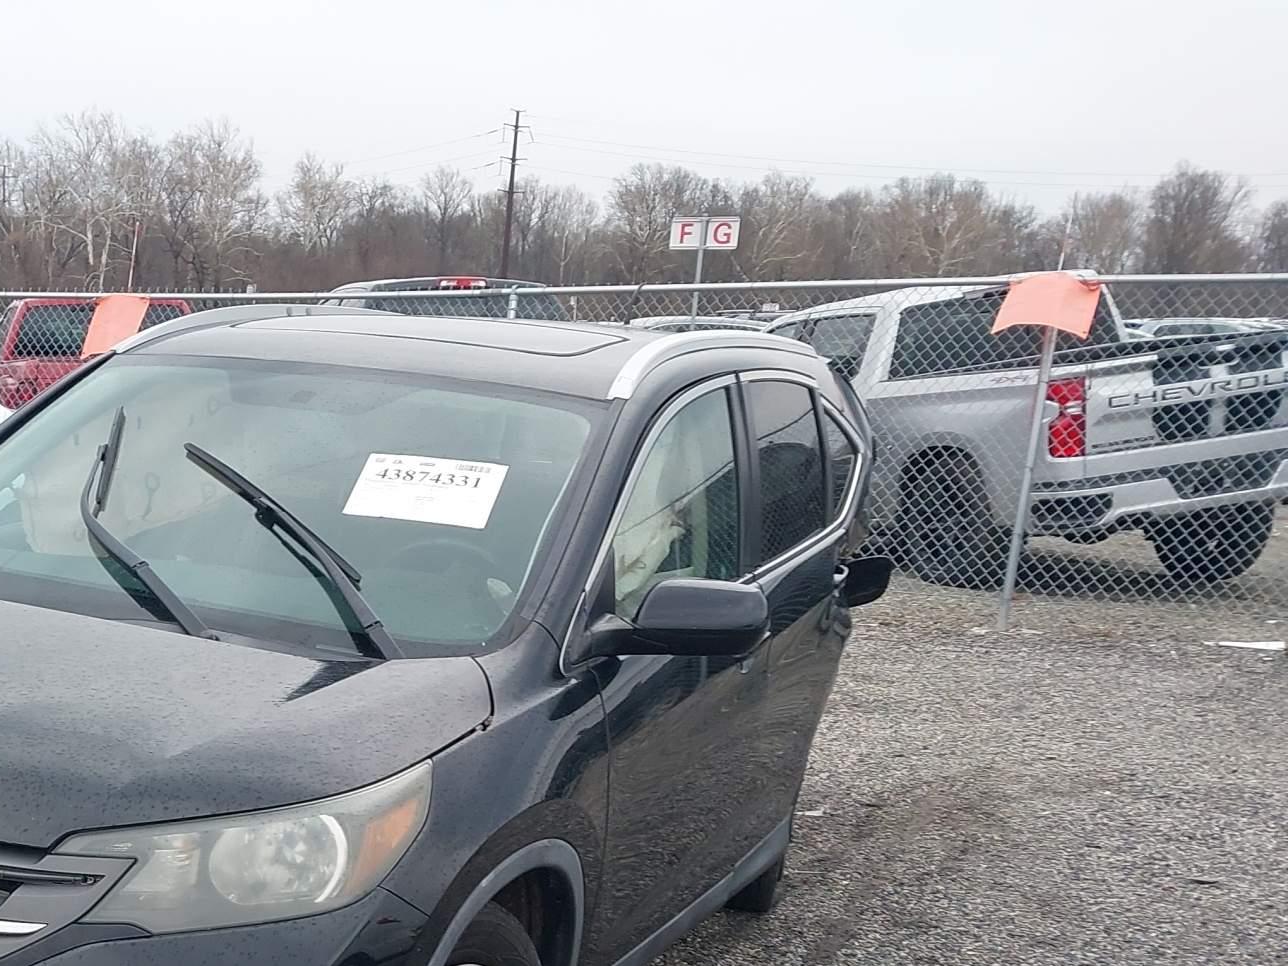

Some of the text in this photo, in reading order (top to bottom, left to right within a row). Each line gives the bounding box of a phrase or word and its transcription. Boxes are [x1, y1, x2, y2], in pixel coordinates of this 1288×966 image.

[679, 222, 733, 245] F G
[375, 467, 481, 489] 43874331
